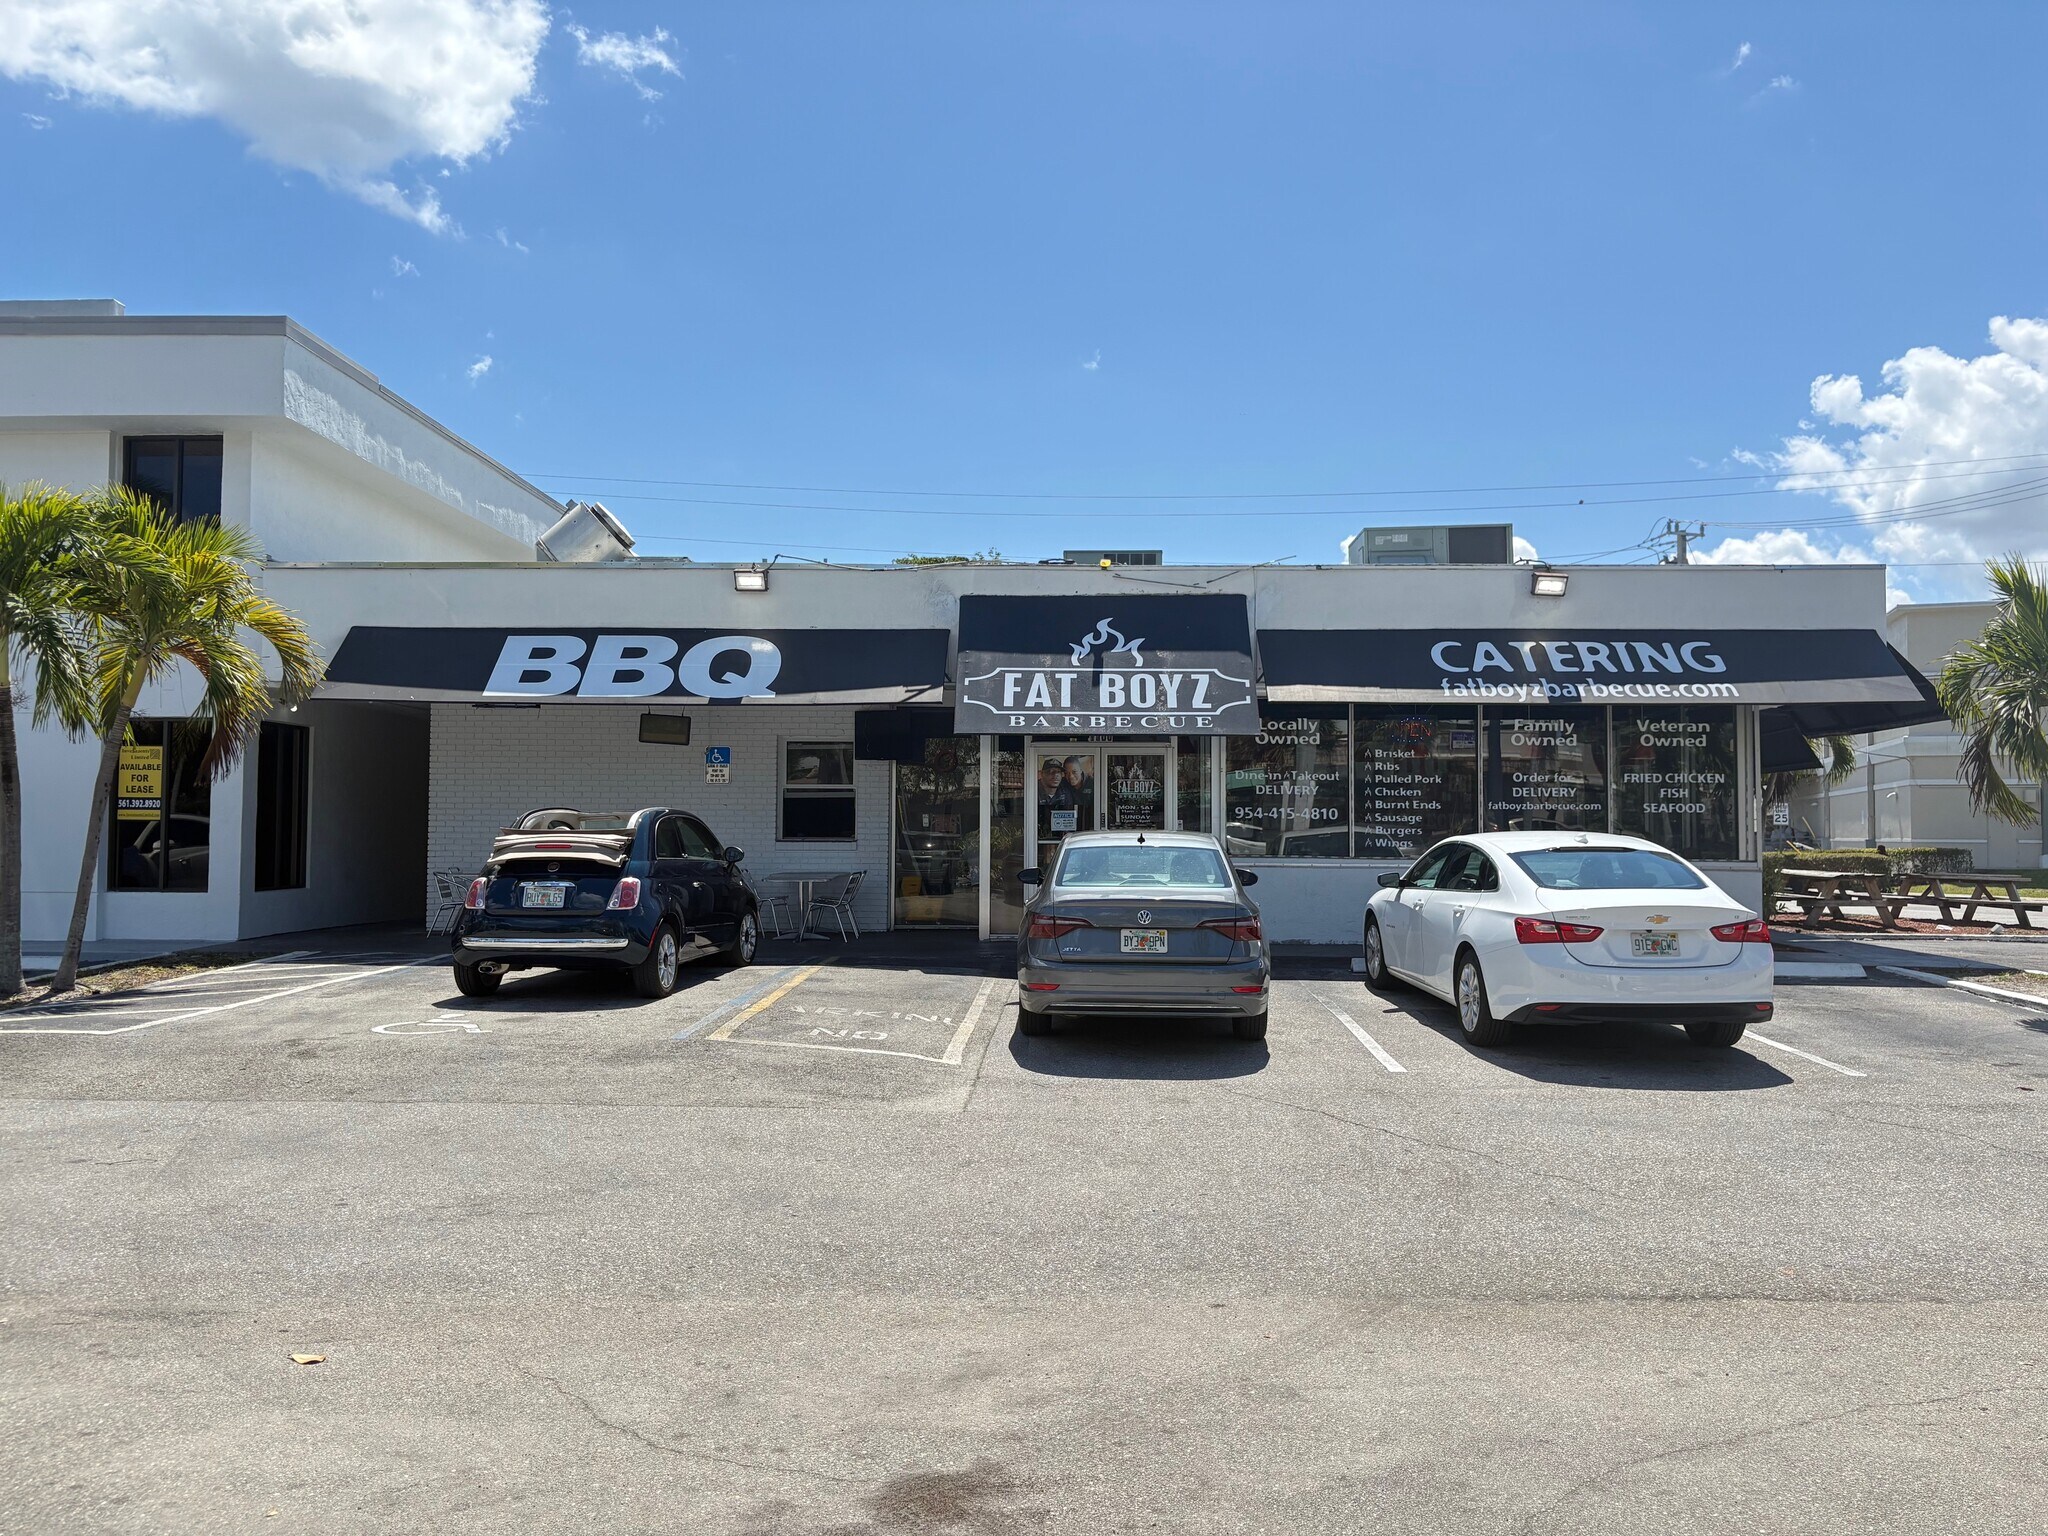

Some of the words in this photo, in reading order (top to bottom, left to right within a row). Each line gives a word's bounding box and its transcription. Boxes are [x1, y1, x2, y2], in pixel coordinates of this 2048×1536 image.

[1430, 641, 1727, 674] CATERING
[482, 635, 782, 699] BBQ
[1003, 672, 1077, 708] FAT
[1099, 673, 1212, 709] BOYZ
[1440, 677, 1740, 702] fatboyzbarbecue.com
[1009, 715, 1214, 728] BARBECUE
[1259, 718, 1318, 733] Locally
[1514, 719, 1575, 735] Family
[1636, 719, 1710, 733] Veteran
[1255, 732, 1320, 745] Owned
[1510, 733, 1577, 747] Owned
[1640, 733, 1707, 747] Owned
[1375, 749, 1415, 758] Brisket
[1375, 761, 1400, 771] Ribs
[131, 775, 149, 783] FOR
[1235, 767, 1282, 781] Dine-in
[1291, 770, 1339, 781] Takeout
[1375, 774, 1411, 784] Pulled
[1415, 774, 1442, 784] Pork
[1512, 772, 1553, 783] Order
[1554, 772, 1573, 783] for
[1624, 773, 1663, 784] FRIED
[1665, 773, 1725, 784] CHICKEN
[126, 786, 154, 794] LEASE
[1117, 781, 1131, 793] FAT
[1134, 781, 1154, 793] BOYZ
[1256, 785, 1319, 795] DELIVERY
[1375, 787, 1421, 797] Chicken
[1512, 787, 1577, 797] DELIVERY
[1660, 788, 1689, 798] FISH
[118, 800, 161, 808] 561.392.8920
[1375, 800, 1410, 810] Burnt
[1413, 800, 1442, 810] Ends
[1488, 800, 1602, 812] fatboyzbarbecue.com
[1643, 803, 1706, 814] SEAFOOD
[1235, 807, 1338, 820] 954-415-4810
[1374, 813, 1422, 825] Sausage
[1775, 813, 1788, 823] 25
[1375, 826, 1422, 837] Burgers
[1375, 838, 1413, 849] Wings
